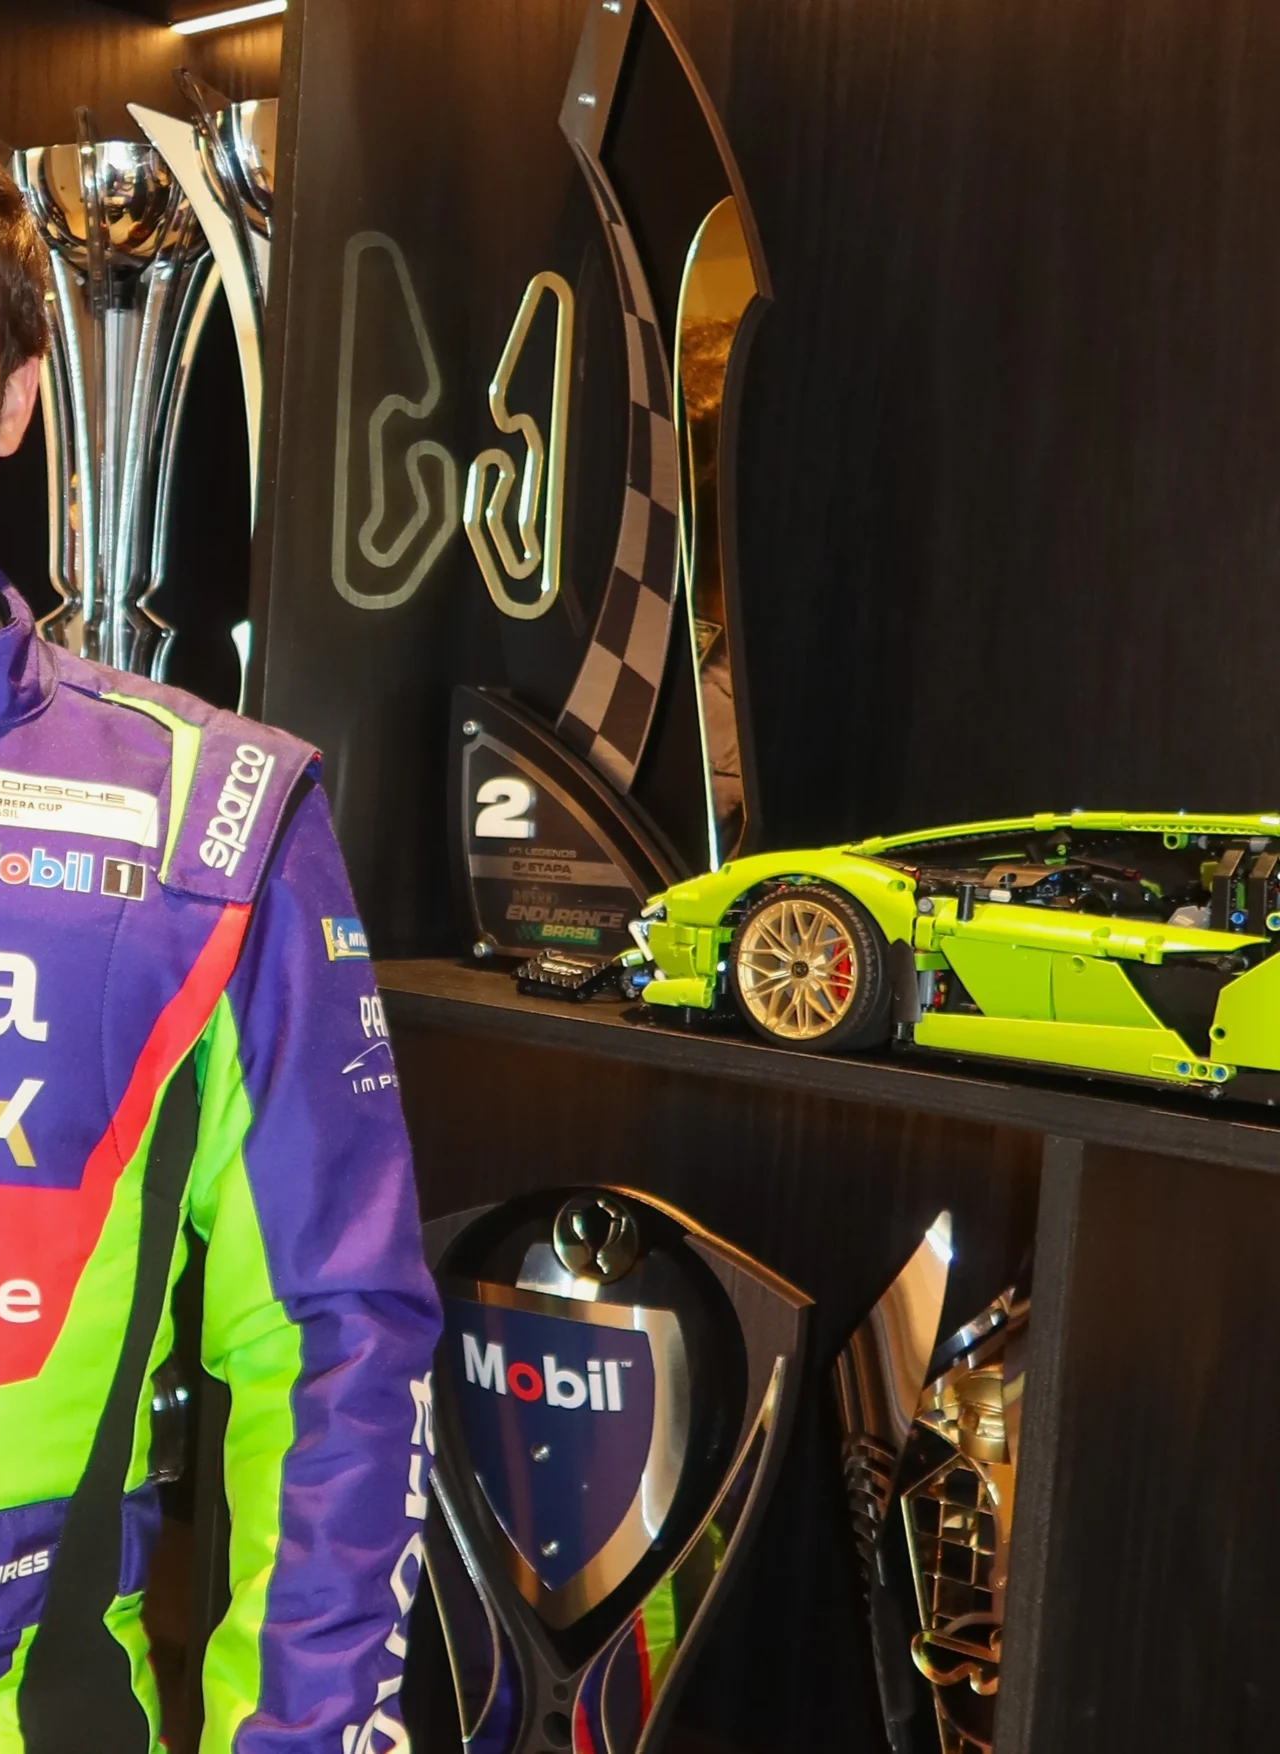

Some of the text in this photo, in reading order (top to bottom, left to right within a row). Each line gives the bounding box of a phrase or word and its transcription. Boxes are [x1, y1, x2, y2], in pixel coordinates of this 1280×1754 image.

[38, 802, 62, 812] CUP
[199, 744, 268, 870] sparco
[475, 776, 534, 839] 2
[525, 847, 578, 859] LEGENDS
[528, 862, 572, 874] ETAPA
[505, 904, 625, 929] ENDURANCE
[541, 923, 597, 941] BRASIL
